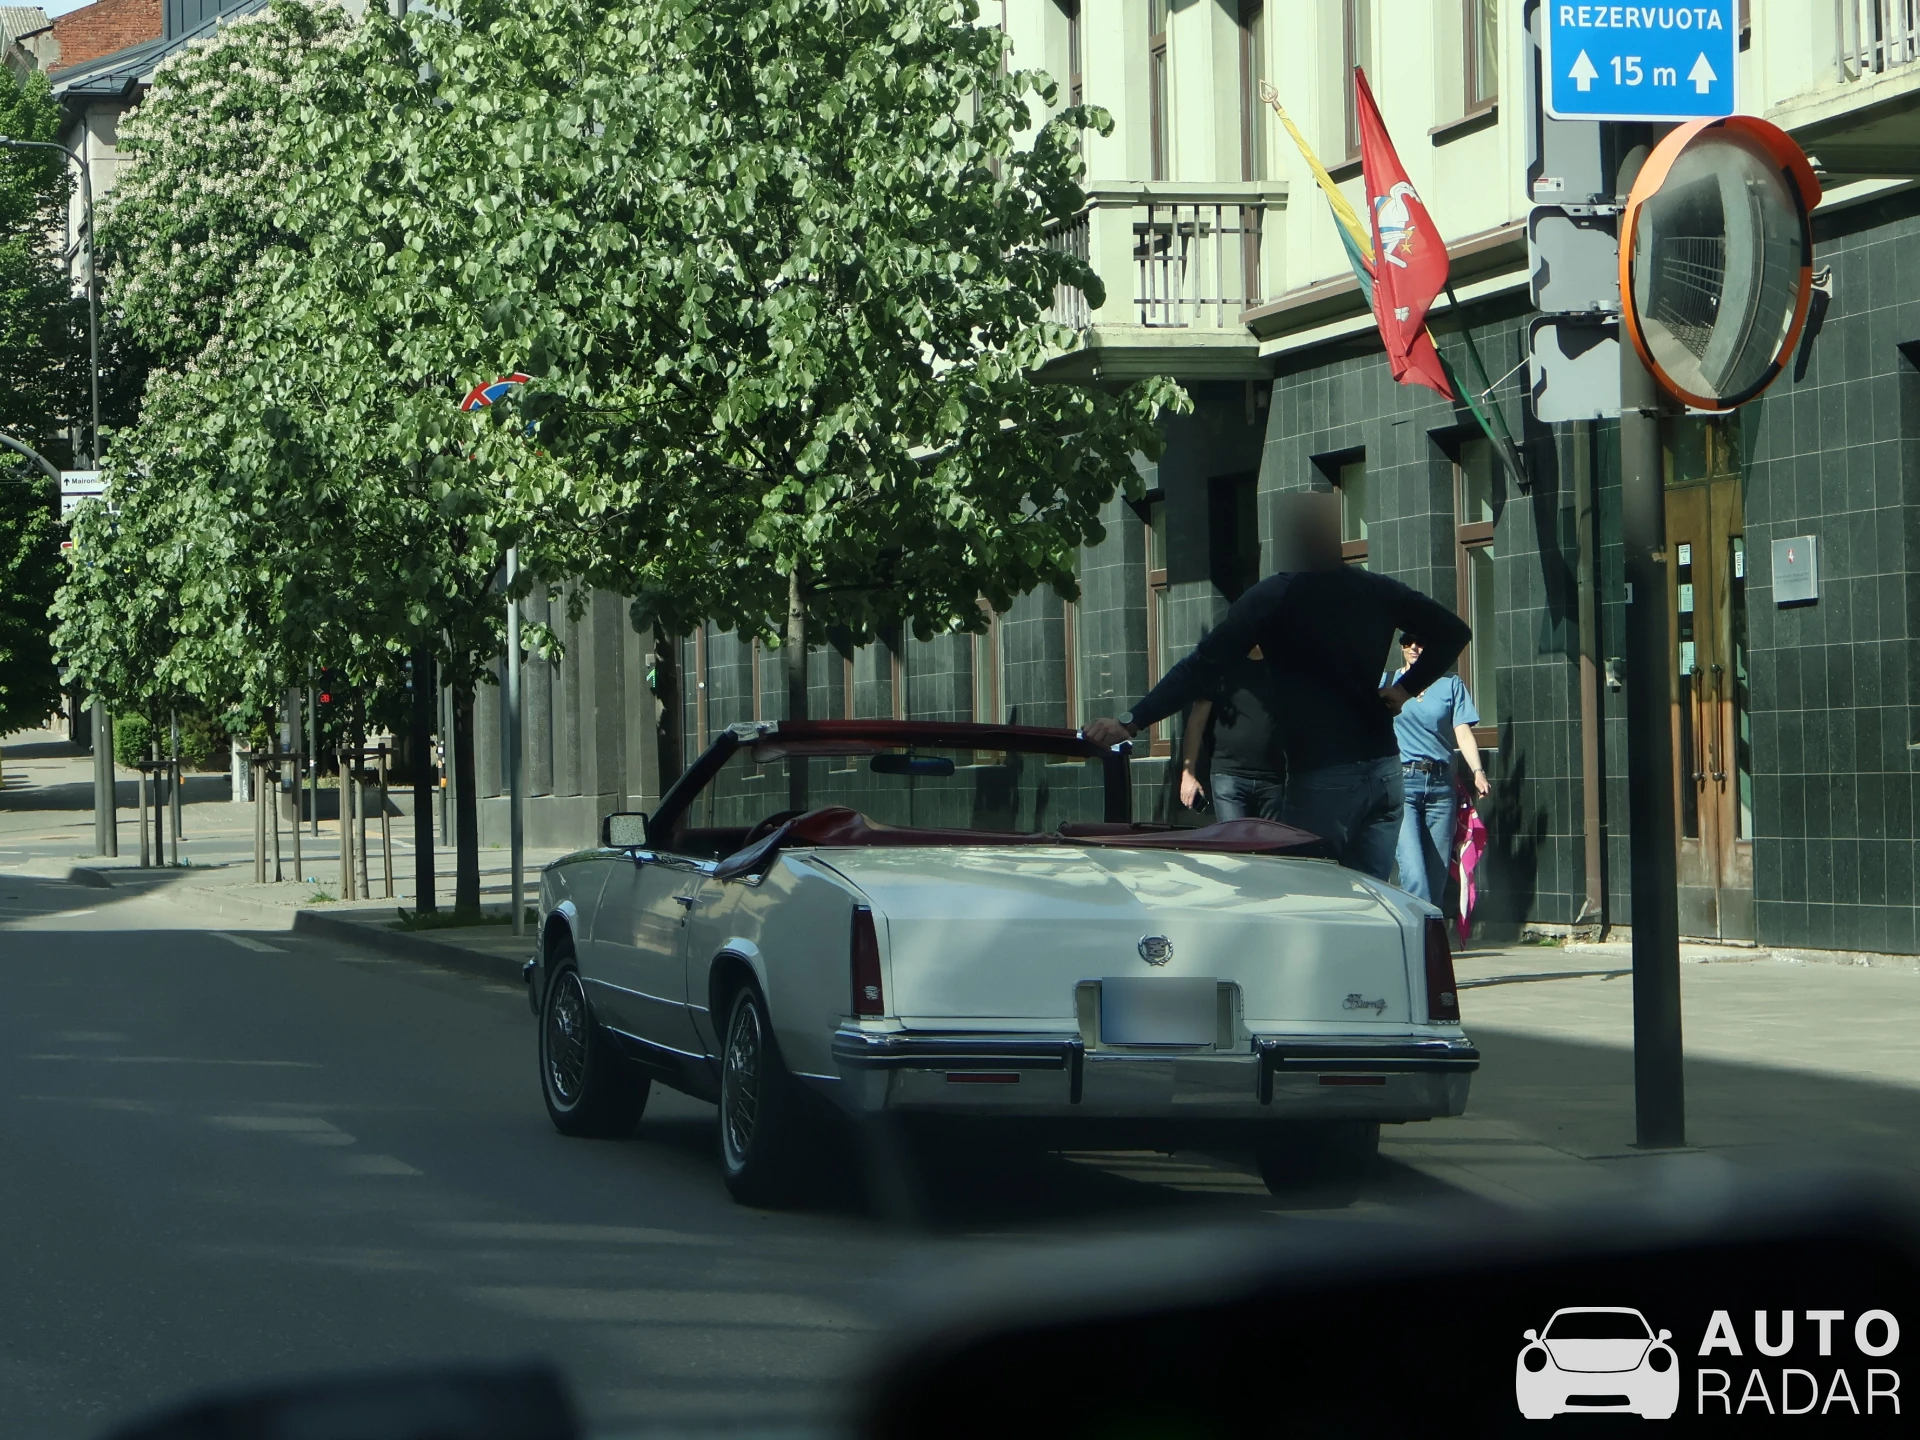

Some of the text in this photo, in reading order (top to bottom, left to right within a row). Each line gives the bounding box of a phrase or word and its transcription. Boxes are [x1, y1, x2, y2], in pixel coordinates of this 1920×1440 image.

[1559, 5, 1723, 30] REZERVUOTA
[1610, 55, 1677, 86] 15 m
